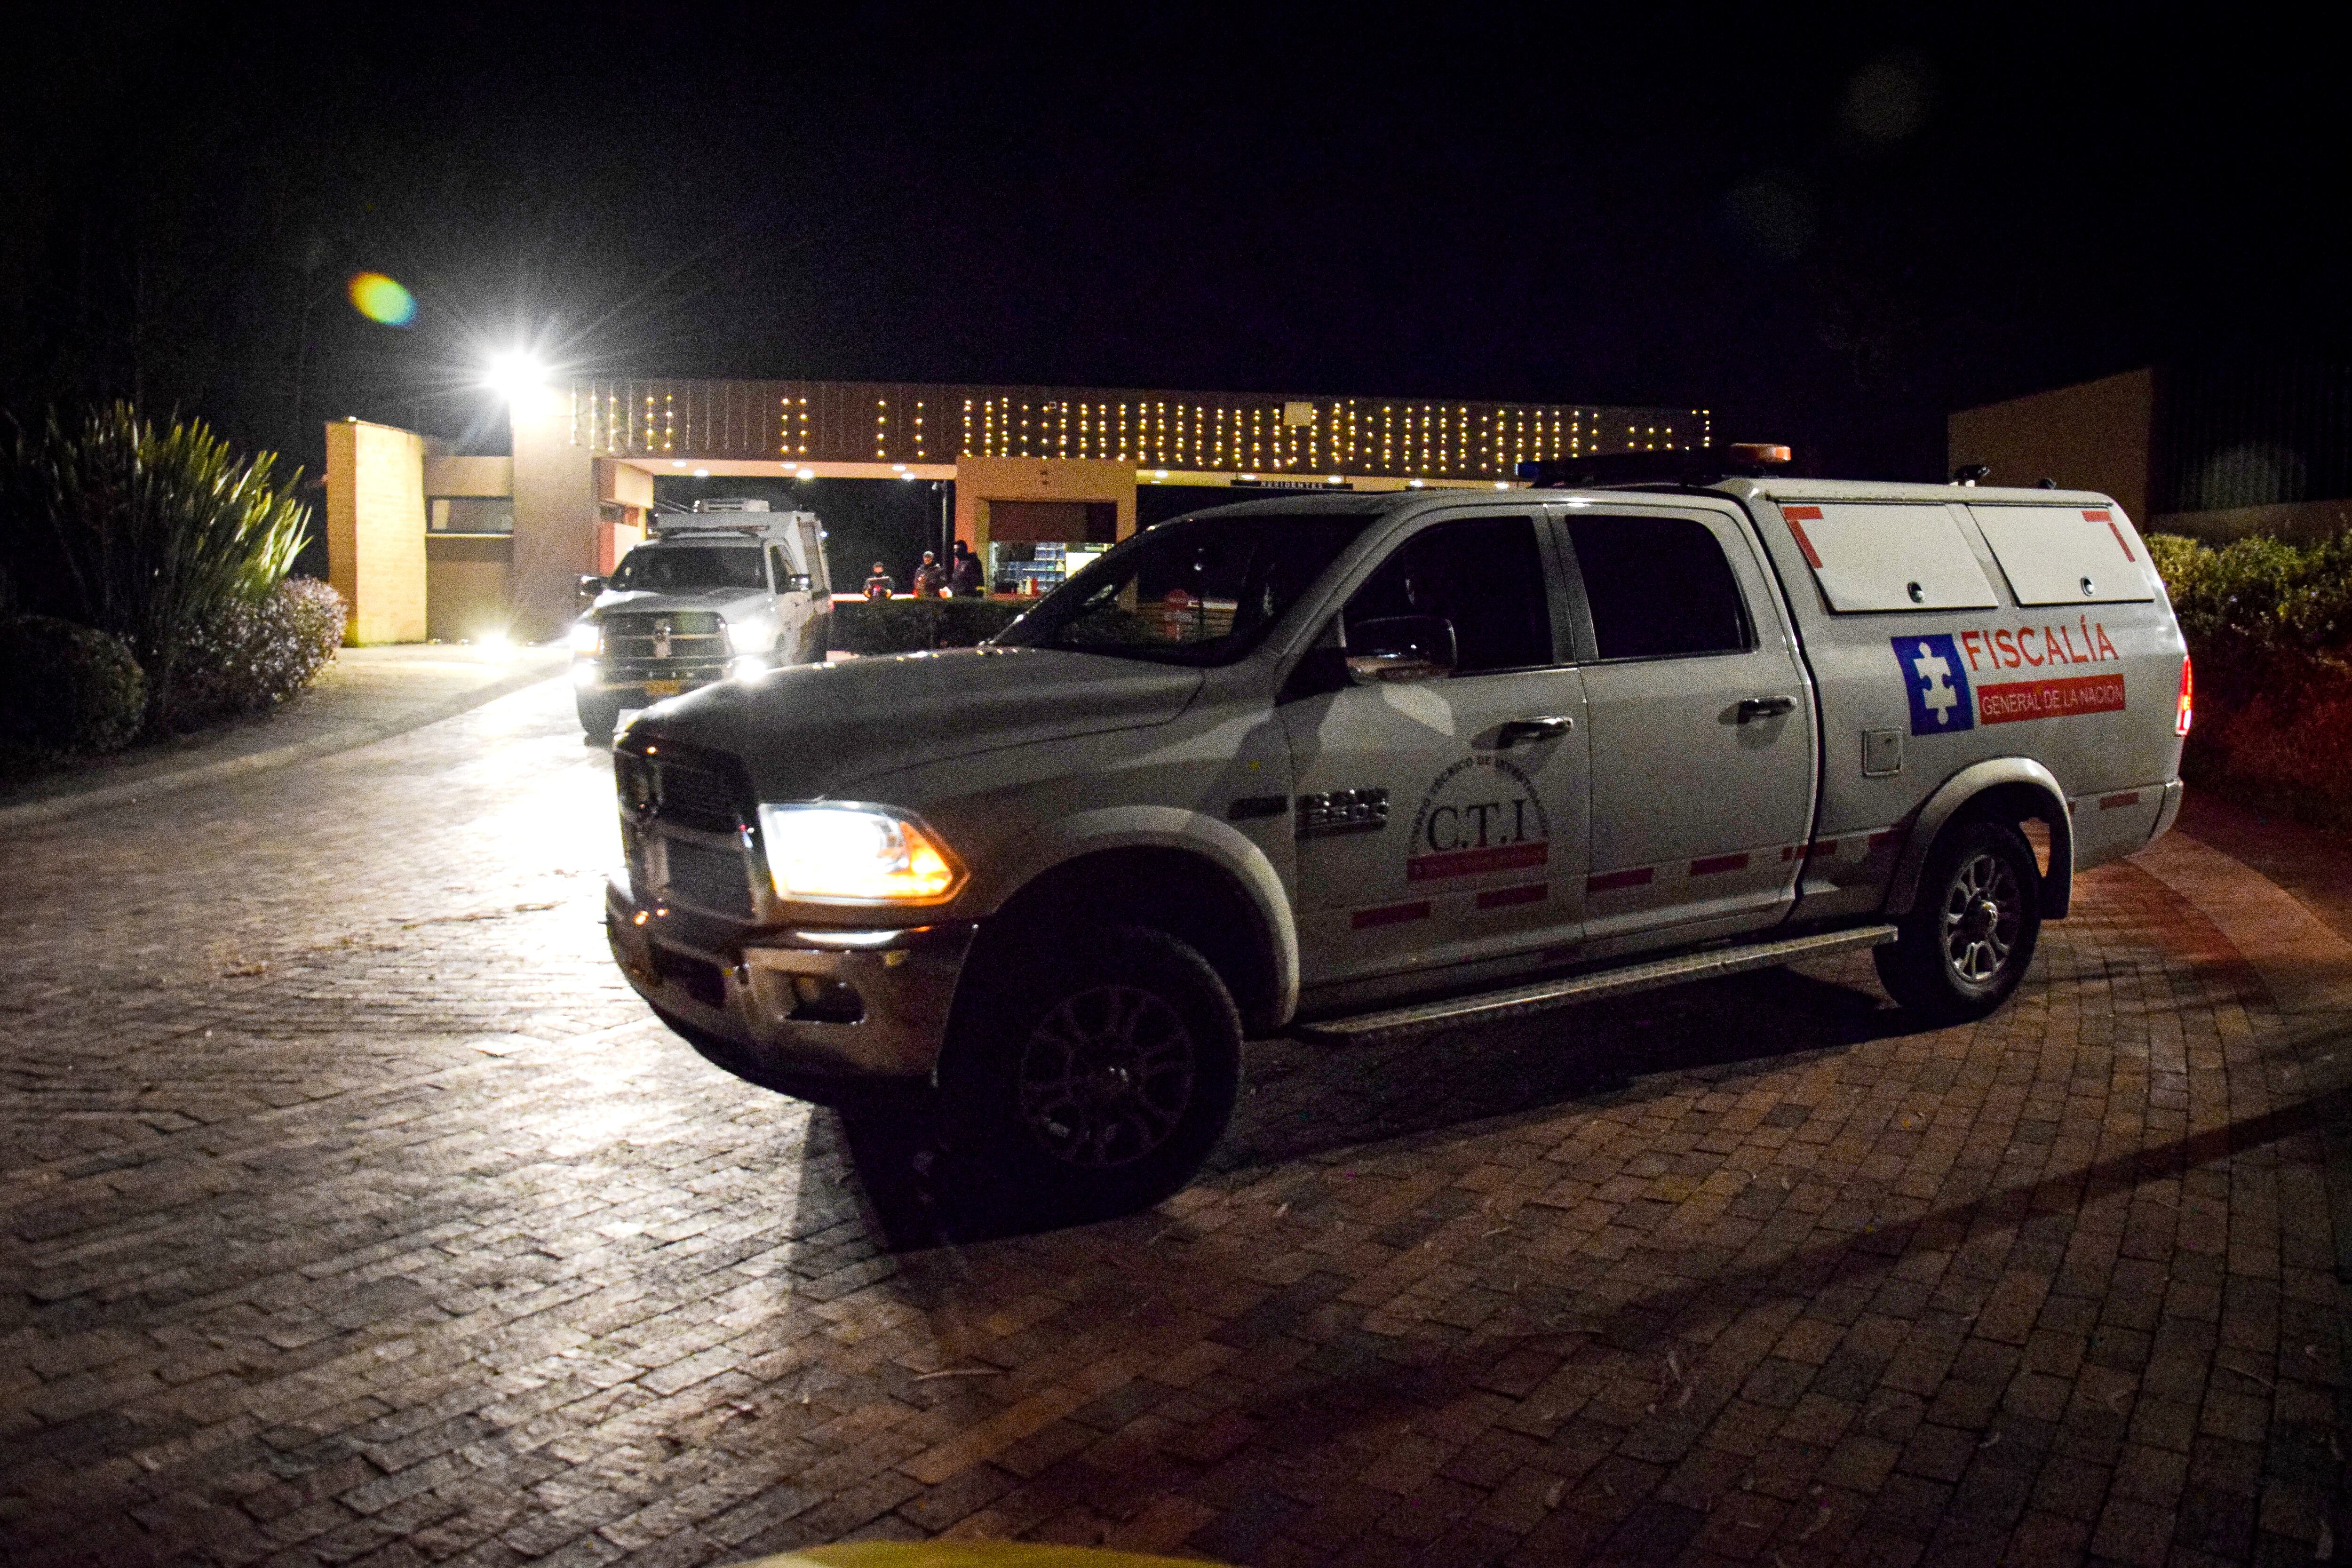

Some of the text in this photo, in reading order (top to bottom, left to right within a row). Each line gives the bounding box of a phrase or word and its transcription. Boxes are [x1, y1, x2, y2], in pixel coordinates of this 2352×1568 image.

[1961, 614, 2119, 671] FISCALÍA
[1982, 693, 2041, 715] GENERAL
[2043, 690, 2061, 709] DE
[2063, 688, 2077, 707] LA
